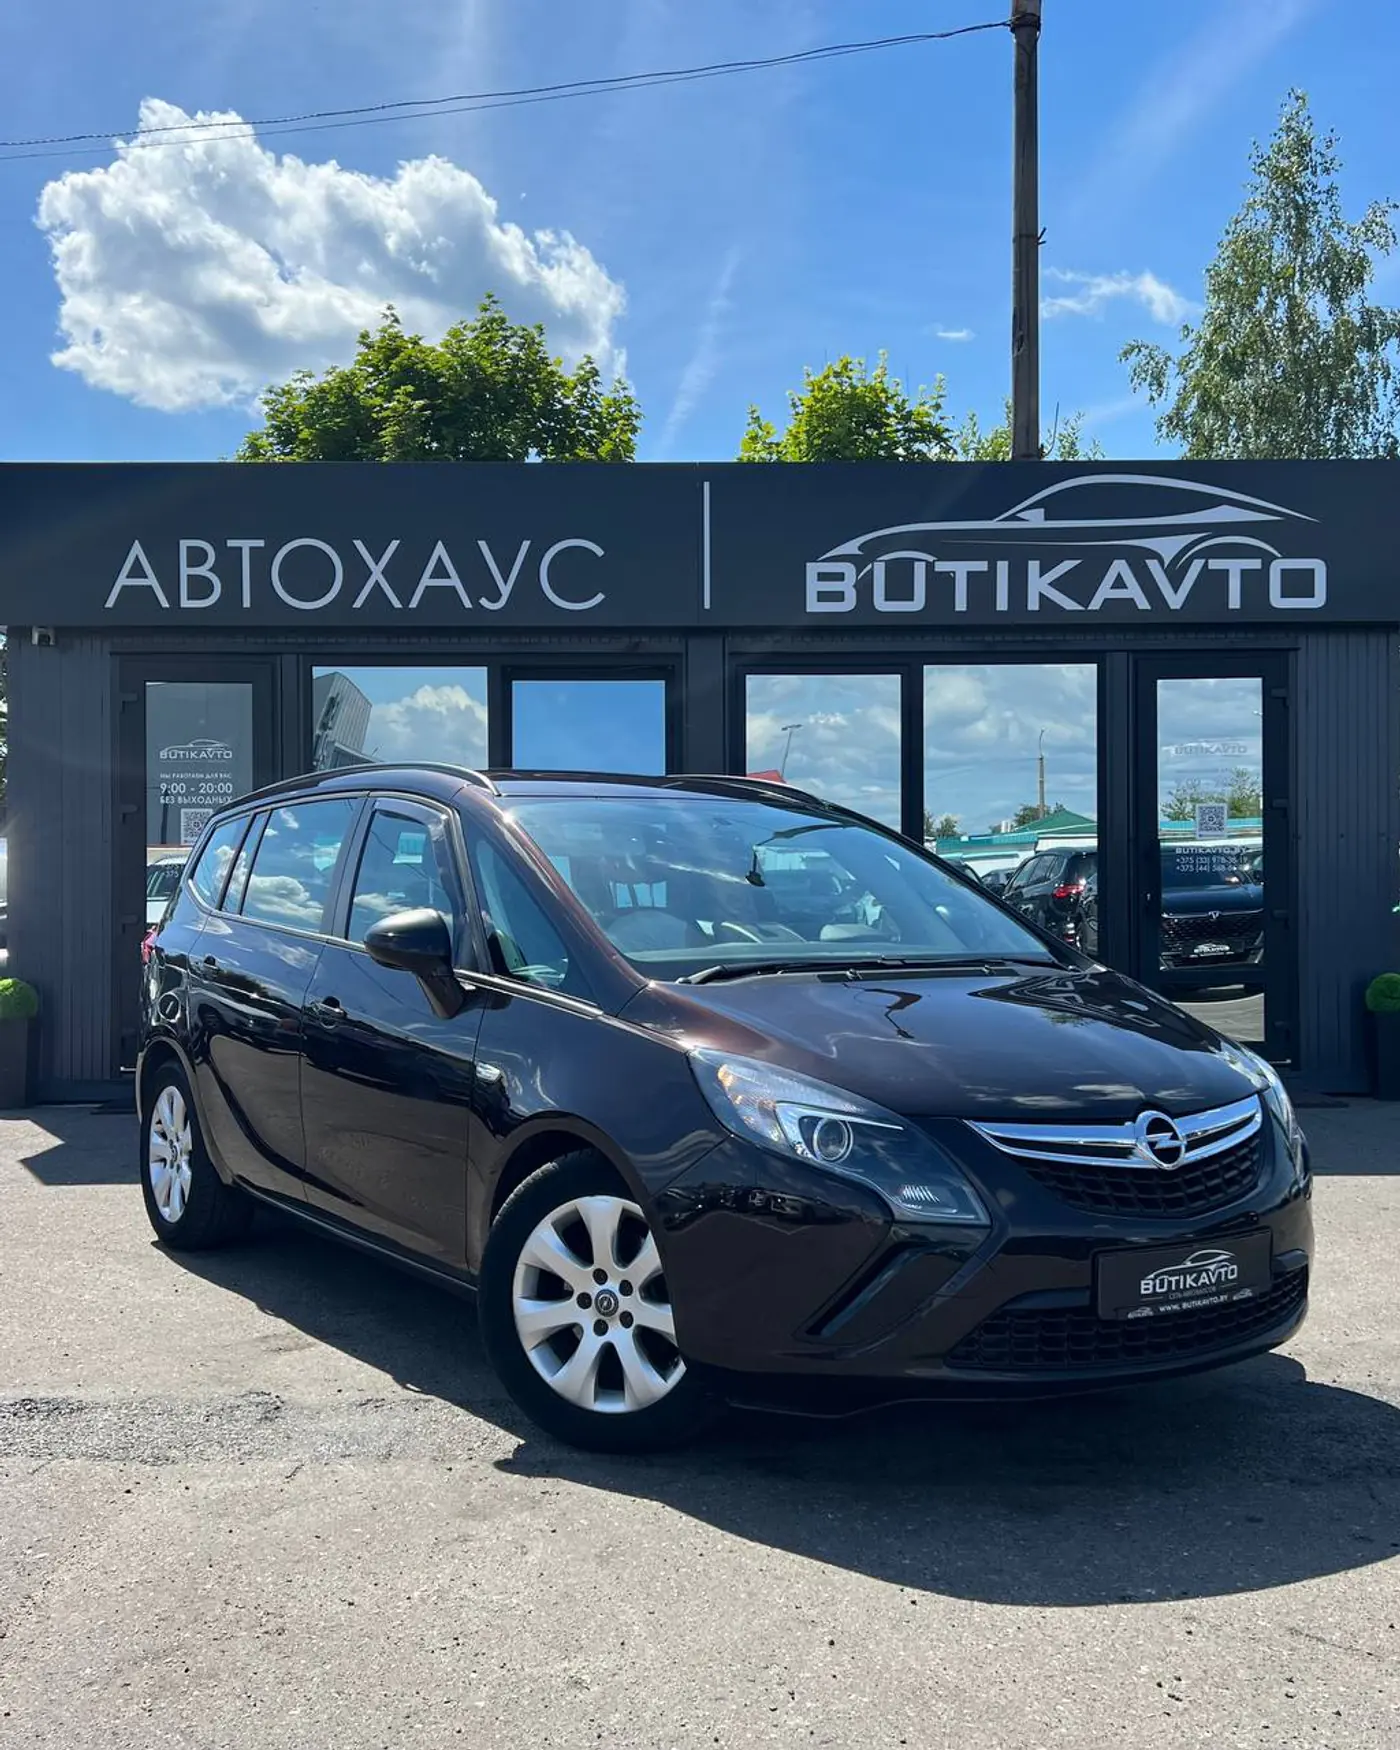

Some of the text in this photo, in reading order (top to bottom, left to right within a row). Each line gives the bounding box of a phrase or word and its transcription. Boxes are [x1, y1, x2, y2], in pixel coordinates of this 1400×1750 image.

[104, 538, 607, 611] АВТОХАУС
[805, 557, 1327, 614] BUTIKAVTO
[160, 750, 233, 759] BUTIKAVTO
[160, 782, 186, 794] 9:00
[198, 782, 233, 794] 20:00
[160, 795, 233, 805] БЕЗ ВЫХОДНЫХ
[1140, 1264, 1238, 1295] BUTIKAVTO
